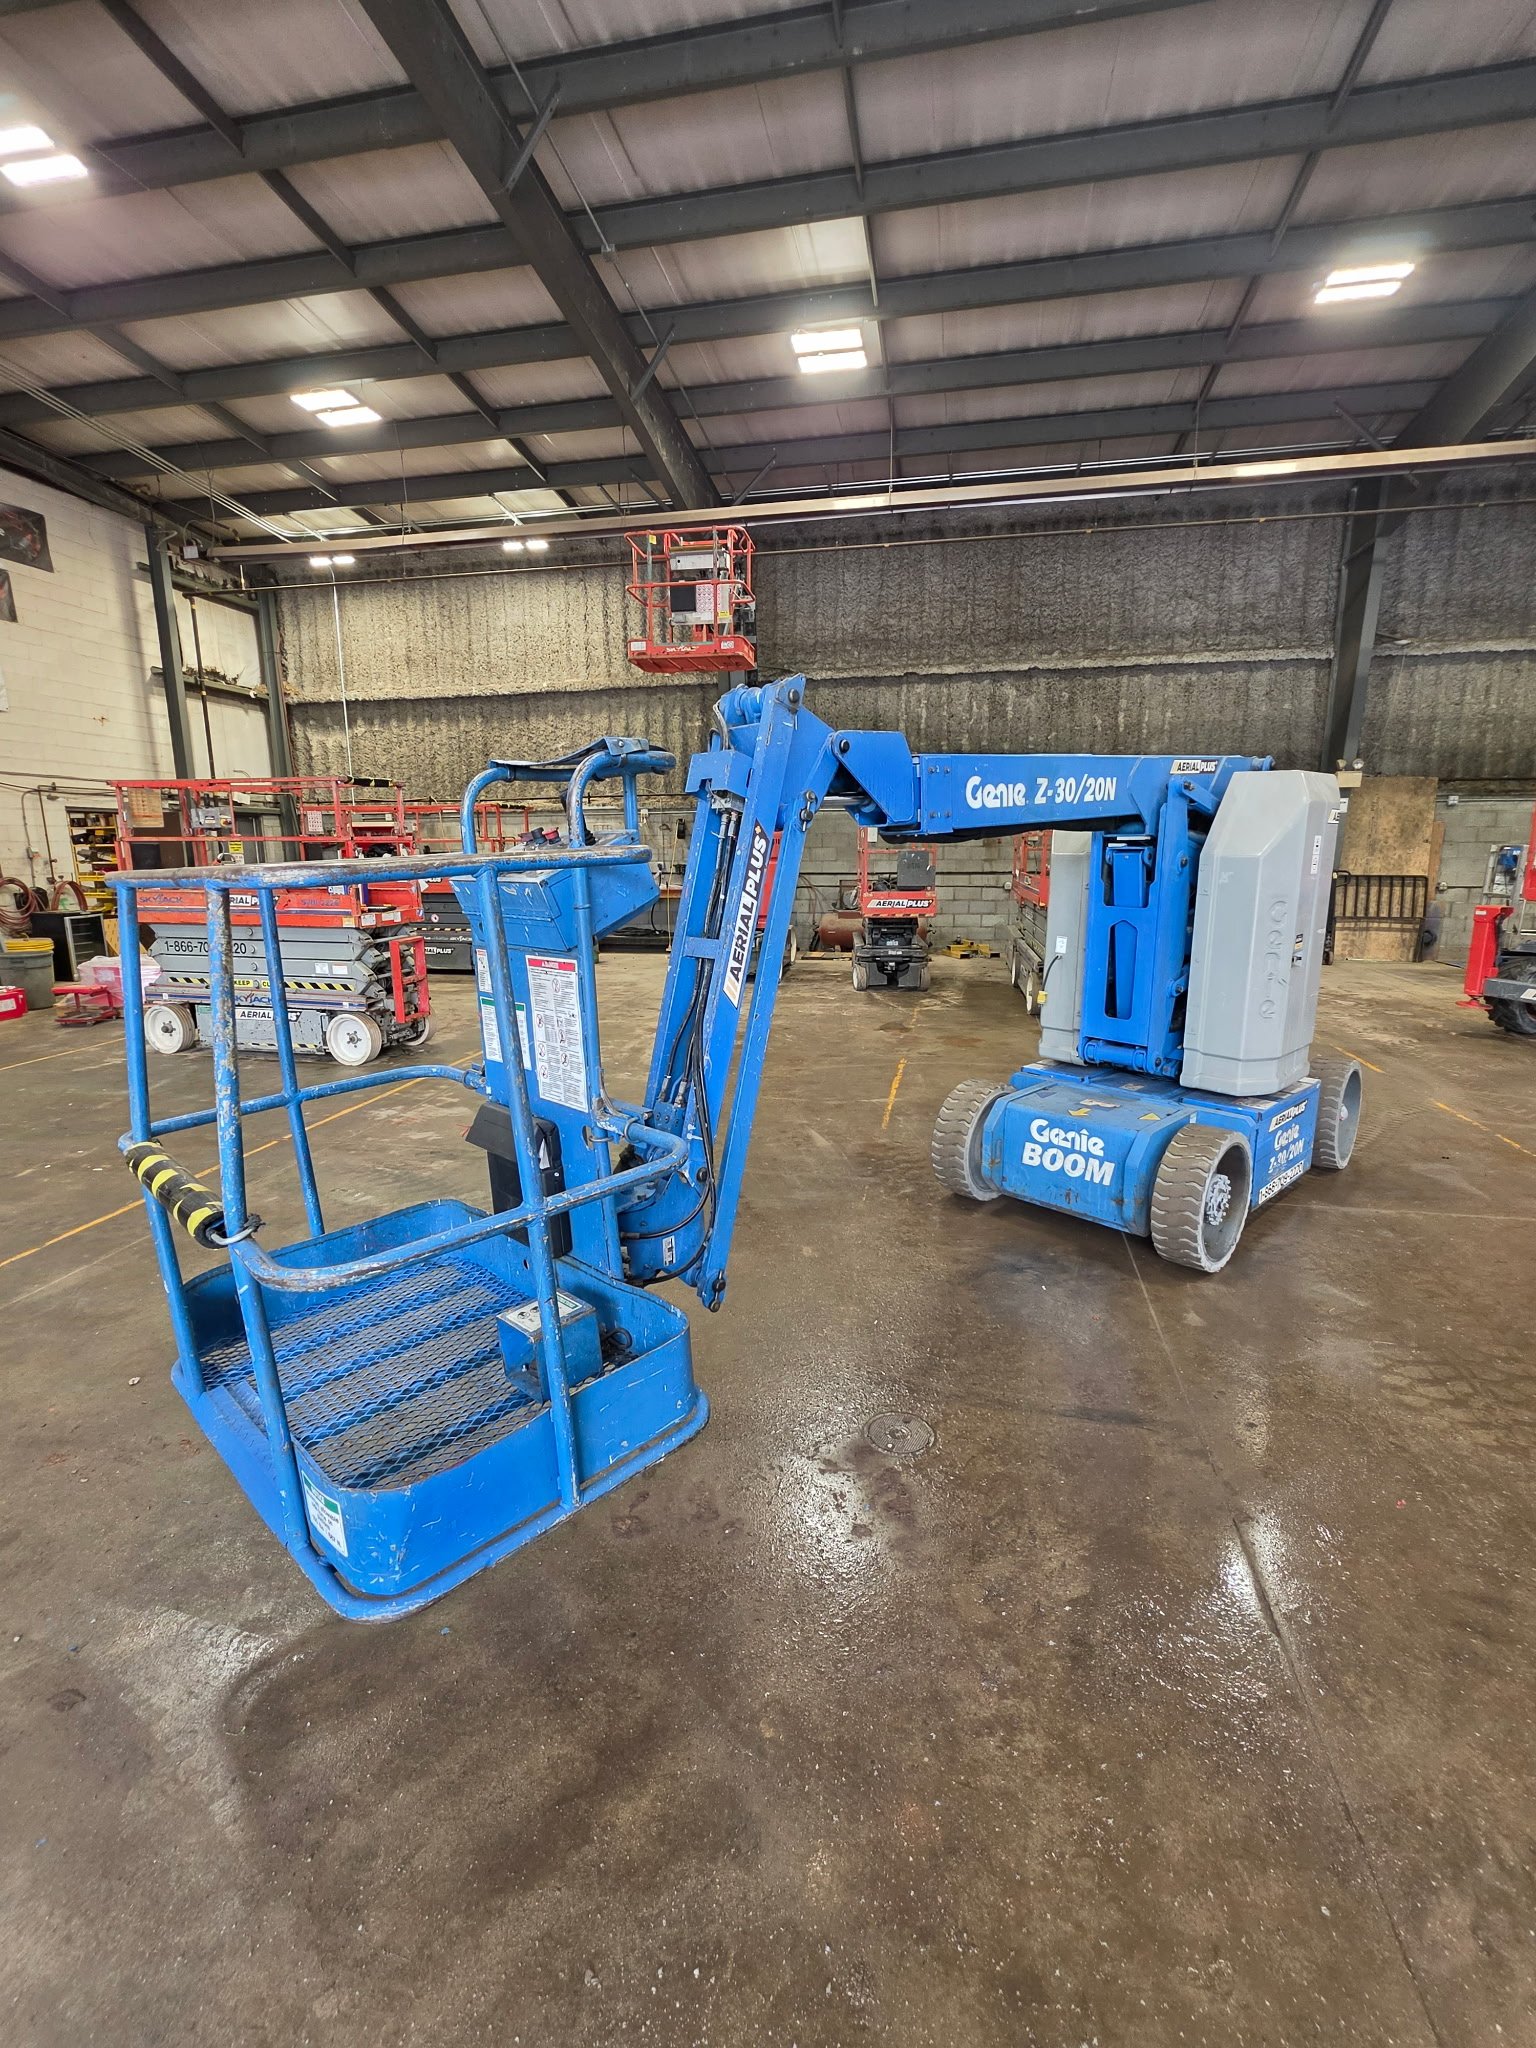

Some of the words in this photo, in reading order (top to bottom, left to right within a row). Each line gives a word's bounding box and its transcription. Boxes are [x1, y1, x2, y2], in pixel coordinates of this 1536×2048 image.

[1177, 761, 1199, 771] AERIAL
[1200, 761, 1216, 772] PLUS
[966, 776, 1025, 809] Genie
[1034, 774, 1116, 804] Z-30/20N
[229, 896, 250, 904] RIAL
[730, 901, 755, 983] AERIAL
[745, 836, 767, 897] PLUS
[240, 1010, 272, 1019] AERIAL
[1029, 1118, 1105, 1157] Genie
[1274, 1123, 1300, 1151] Genie
[1022, 1142, 1115, 1186] BOOM
